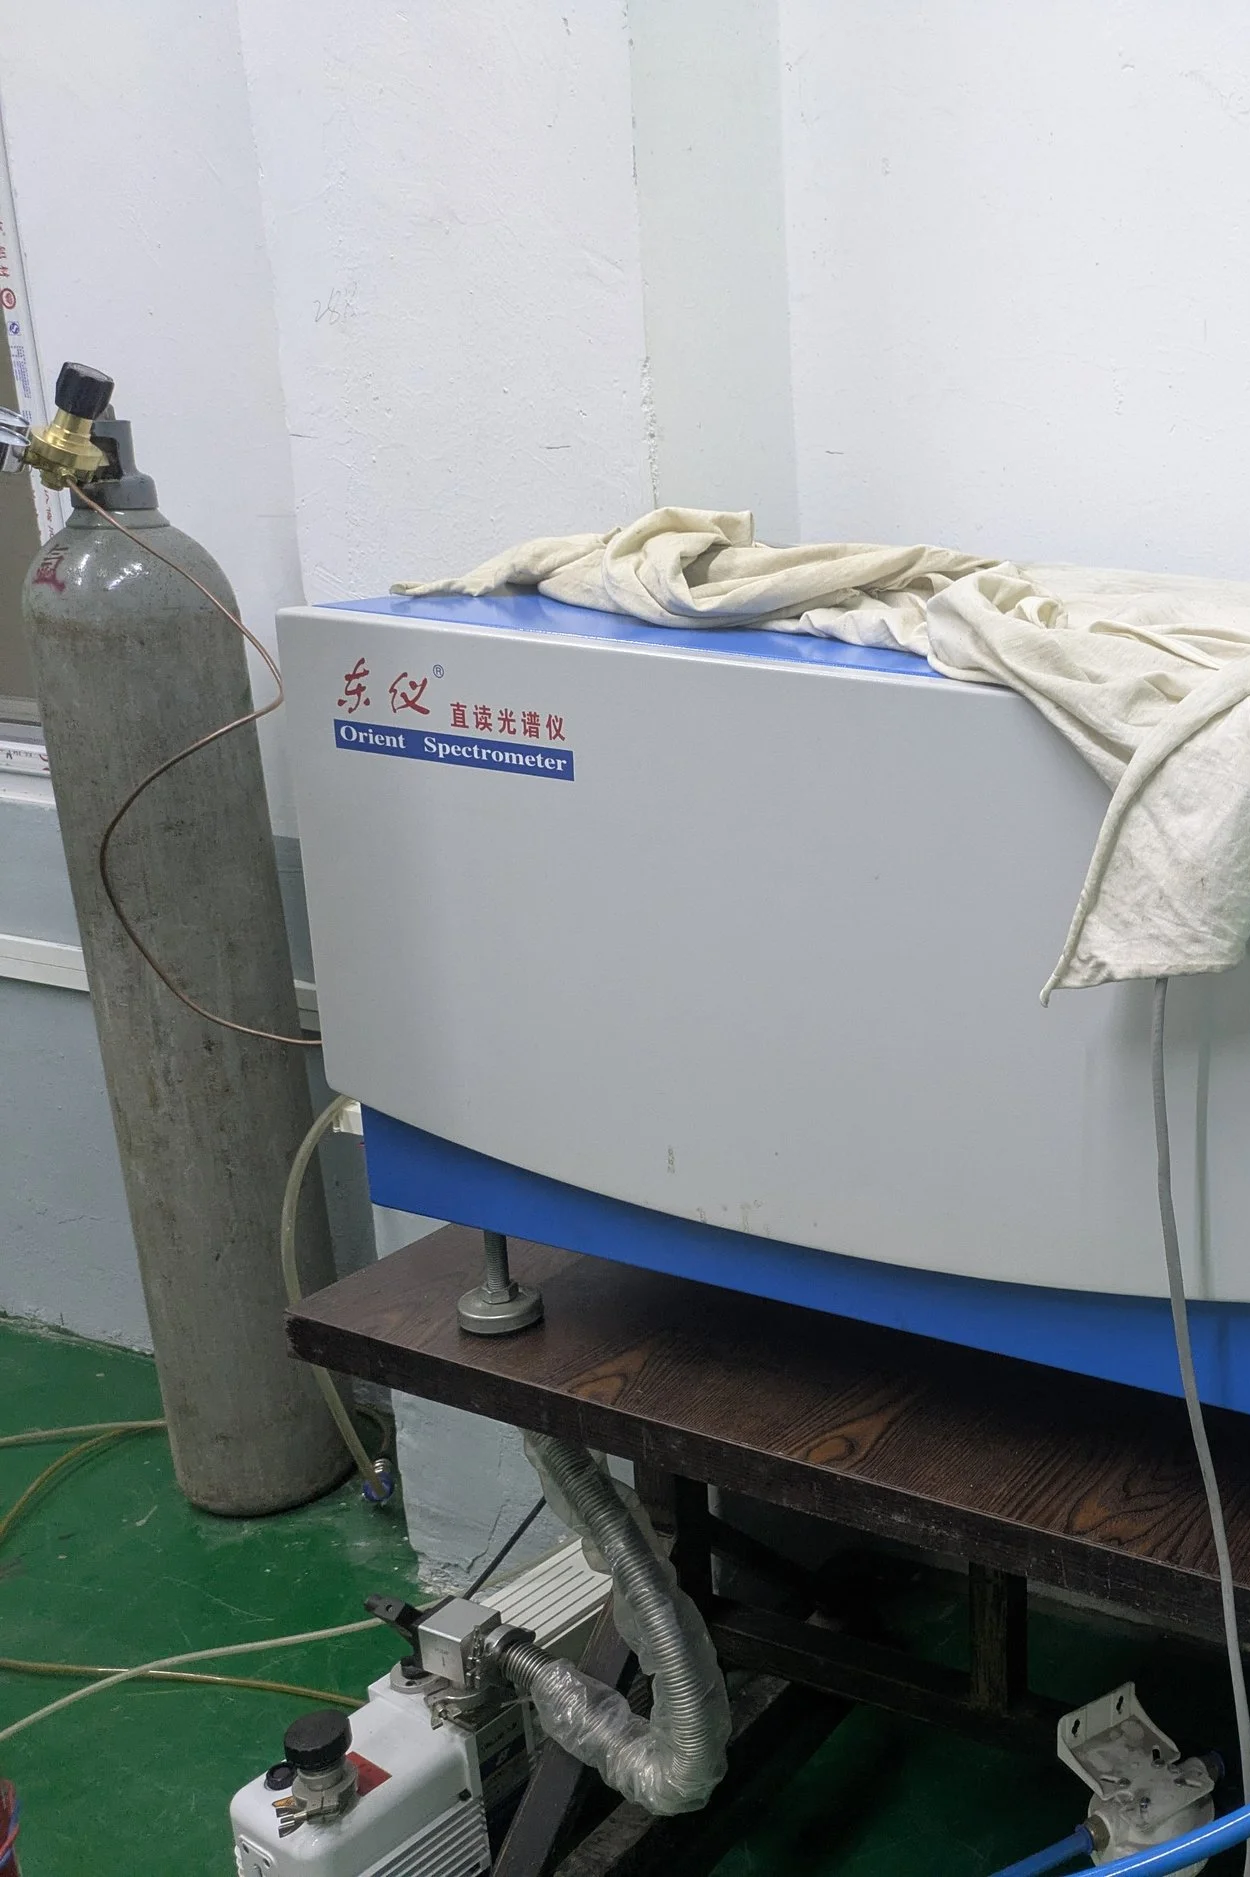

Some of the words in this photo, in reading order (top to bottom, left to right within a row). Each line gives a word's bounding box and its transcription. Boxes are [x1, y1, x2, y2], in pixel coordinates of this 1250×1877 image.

[450, 702, 566, 742] 直读光谱仪
[339, 725, 406, 750] Orient
[424, 736, 567, 772] Spectrometer
